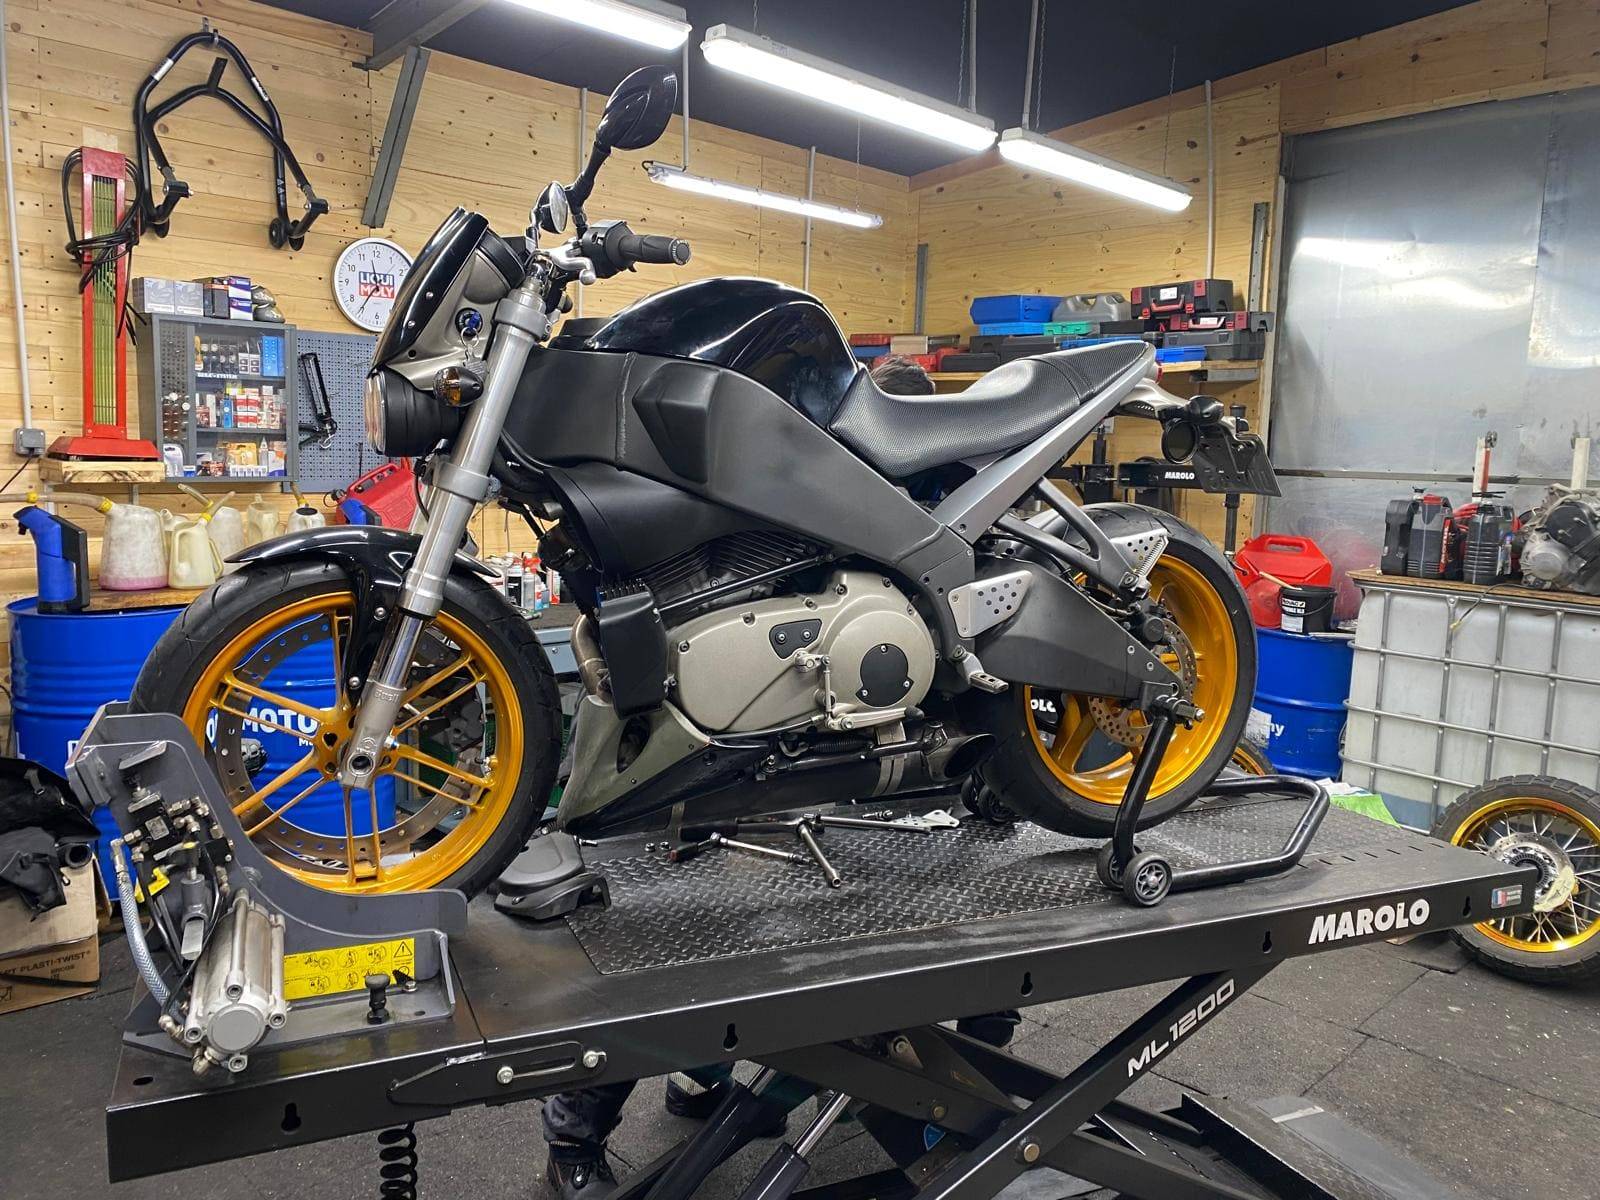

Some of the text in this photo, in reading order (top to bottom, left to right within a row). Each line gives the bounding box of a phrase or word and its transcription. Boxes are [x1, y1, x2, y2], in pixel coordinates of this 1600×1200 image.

[373, 250, 380, 258] 12
[347, 264, 356, 272] 10
[360, 272, 394, 286] LIQUI
[360, 285, 394, 298] MOLY
[1164, 471, 1195, 480] MAROLO
[1308, 898, 1430, 945] MAROLO
